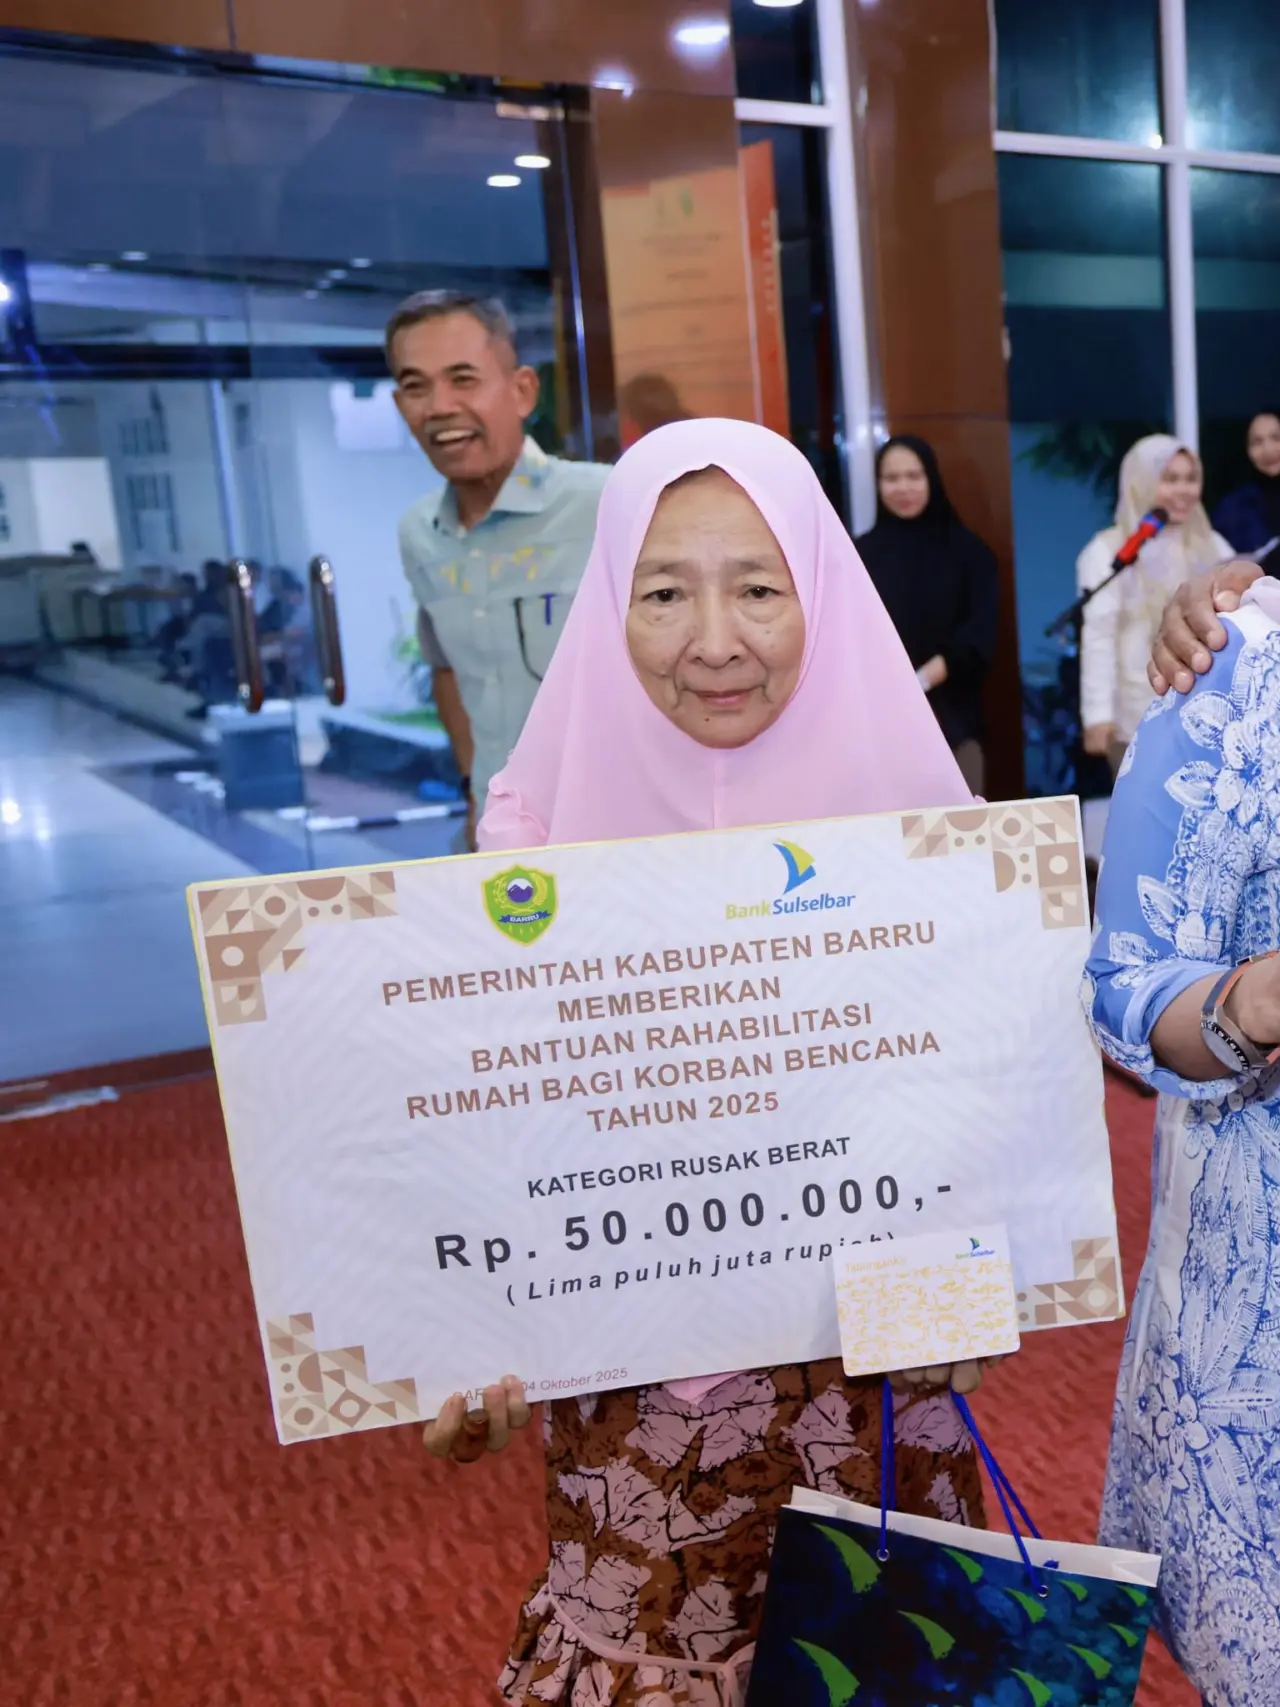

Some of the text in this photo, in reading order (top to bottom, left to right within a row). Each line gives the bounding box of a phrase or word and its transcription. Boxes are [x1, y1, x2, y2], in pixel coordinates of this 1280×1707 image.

[509, 913, 541, 923] BARRU
[382, 920, 936, 1006] PEMERINTAH KABUPATEN BARRU
[557, 976, 781, 1024] MEMBERIKAN
[471, 1002, 872, 1074] BANTUAN RAHABILITASI
[406, 1031, 941, 1120] RUMAH BAGI KORBAN BENCANA
[587, 1091, 780, 1133] TAHUN 2025
[527, 1136, 851, 1199] KATEGORI RUSAK BERAT
[434, 1175, 952, 1274] Rp. 50.000.000,-
[506, 1274, 603, 1307] (Lima
[615, 1257, 701, 1289] puluh
[711, 1250, 772, 1278] juta
[540, 1374, 592, 1392] Oktober
[596, 1367, 628, 1383] 2025
